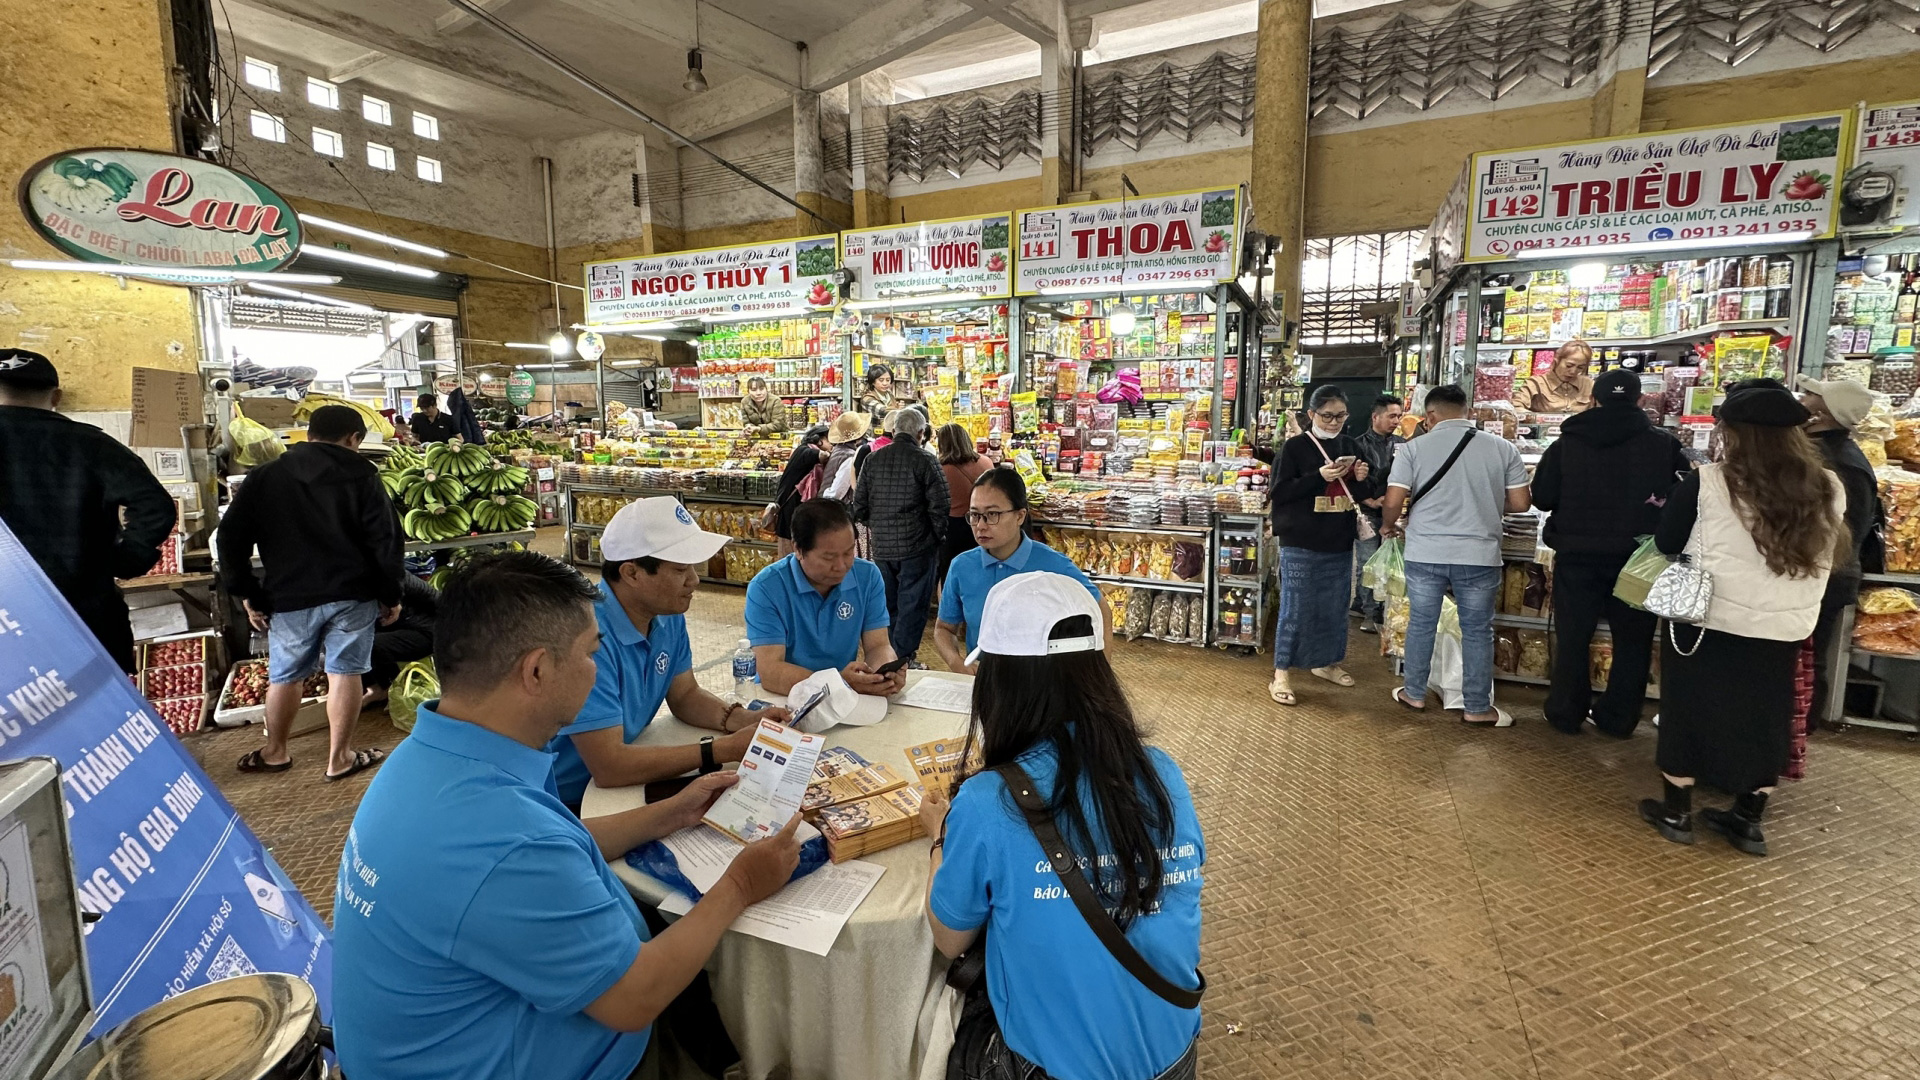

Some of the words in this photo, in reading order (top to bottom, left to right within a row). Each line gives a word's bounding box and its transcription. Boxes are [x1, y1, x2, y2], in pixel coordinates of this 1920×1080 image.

[1560, 149, 1602, 168] Hàng
[1605, 147, 1638, 166] Đặc
[1642, 141, 1673, 160] Sản
[1677, 135, 1711, 157] Chợ
[1712, 132, 1741, 153] Đà
[1744, 128, 1778, 151] Lạt
[1504, 184, 1515, 193] SỐ
[1720, 161, 1785, 203] LY
[117, 168, 290, 237] Lan
[1069, 210, 1096, 224] Hàng
[1097, 207, 1118, 222] Đặc
[1139, 203, 1159, 218] Chợ
[1161, 201, 1179, 216] Đà
[1180, 198, 1199, 212] Lạt
[1484, 193, 1539, 219] 142
[1485, 224, 1529, 237] CHUYÊN
[1530, 221, 1562, 233] CUNG
[1566, 216, 1587, 231] CẤP
[1602, 219, 1610, 227] &
[1630, 211, 1652, 226] CÁC
[1654, 212, 1683, 226] LOẠI
[1720, 203, 1737, 219] CÀ
[1741, 203, 1769, 218] PHÊ,
[1681, 224, 1728, 239] 0913
[1736, 222, 1769, 236] 241
[1778, 218, 1817, 234] 935
[44, 211, 84, 240] ĐẶC
[89, 228, 130, 258] BIỆT
[136, 242, 188, 268] CHUỐI
[190, 248, 236, 269] LABA
[262, 236, 293, 263] LẠT
[848, 247, 864, 256] 140
[1022, 239, 1057, 258] 141
[1071, 219, 1195, 260] THOA
[1513, 238, 1556, 252] 0913
[1561, 235, 1592, 248] 241
[1597, 232, 1631, 247] 935
[631, 260, 663, 275] Hàng
[666, 256, 690, 271] Đặc
[691, 254, 714, 268] Sản
[716, 250, 740, 266] Chợ
[742, 249, 764, 263] Đà
[766, 246, 791, 260] Lạt
[872, 248, 903, 276] KIM
[1023, 265, 1047, 277] CHUYÊN
[1048, 264, 1064, 275] CUNG
[1064, 261, 1078, 274] CẤP
[1086, 263, 1091, 272] &
[1101, 260, 1115, 272] ĐẶC
[1130, 256, 1144, 269] TRÀ
[1188, 254, 1206, 264] TREO
[631, 274, 696, 298] NGỌC
[704, 262, 769, 294] THỦY
[778, 265, 791, 288] 1
[985, 284, 997, 293] 119
[1051, 276, 1078, 287] 0987
[1080, 275, 1100, 285] 675
[1103, 274, 1122, 284] 148
[1137, 271, 1166, 282] 0347
[1168, 269, 1191, 280] 296
[1193, 267, 1216, 278] 631
[599, 303, 625, 312] CHUYÊN
[626, 302, 645, 310] CUNG
[737, 292, 748, 303] CÀ
[681, 308, 697, 316] 0832
[698, 307, 710, 315] 499
[743, 303, 761, 312] 0832
[762, 302, 776, 311] 499
[776, 300, 791, 310] 638
[6, 665, 78, 726] KHỎE
[63, 733, 135, 804] THÀNH
[117, 708, 160, 754] VIÊN
[109, 832, 155, 884] HỘ
[138, 805, 179, 852] GIA
[162, 771, 204, 823] ĐÌNH
[1178, 841, 1196, 859] HIỆN
[1033, 884, 1061, 900] BẢO
[180, 949, 204, 984] HIỂM
[199, 929, 216, 956] XÃ
[208, 912, 226, 937] HỘI
[219, 895, 233, 920] SỐ
